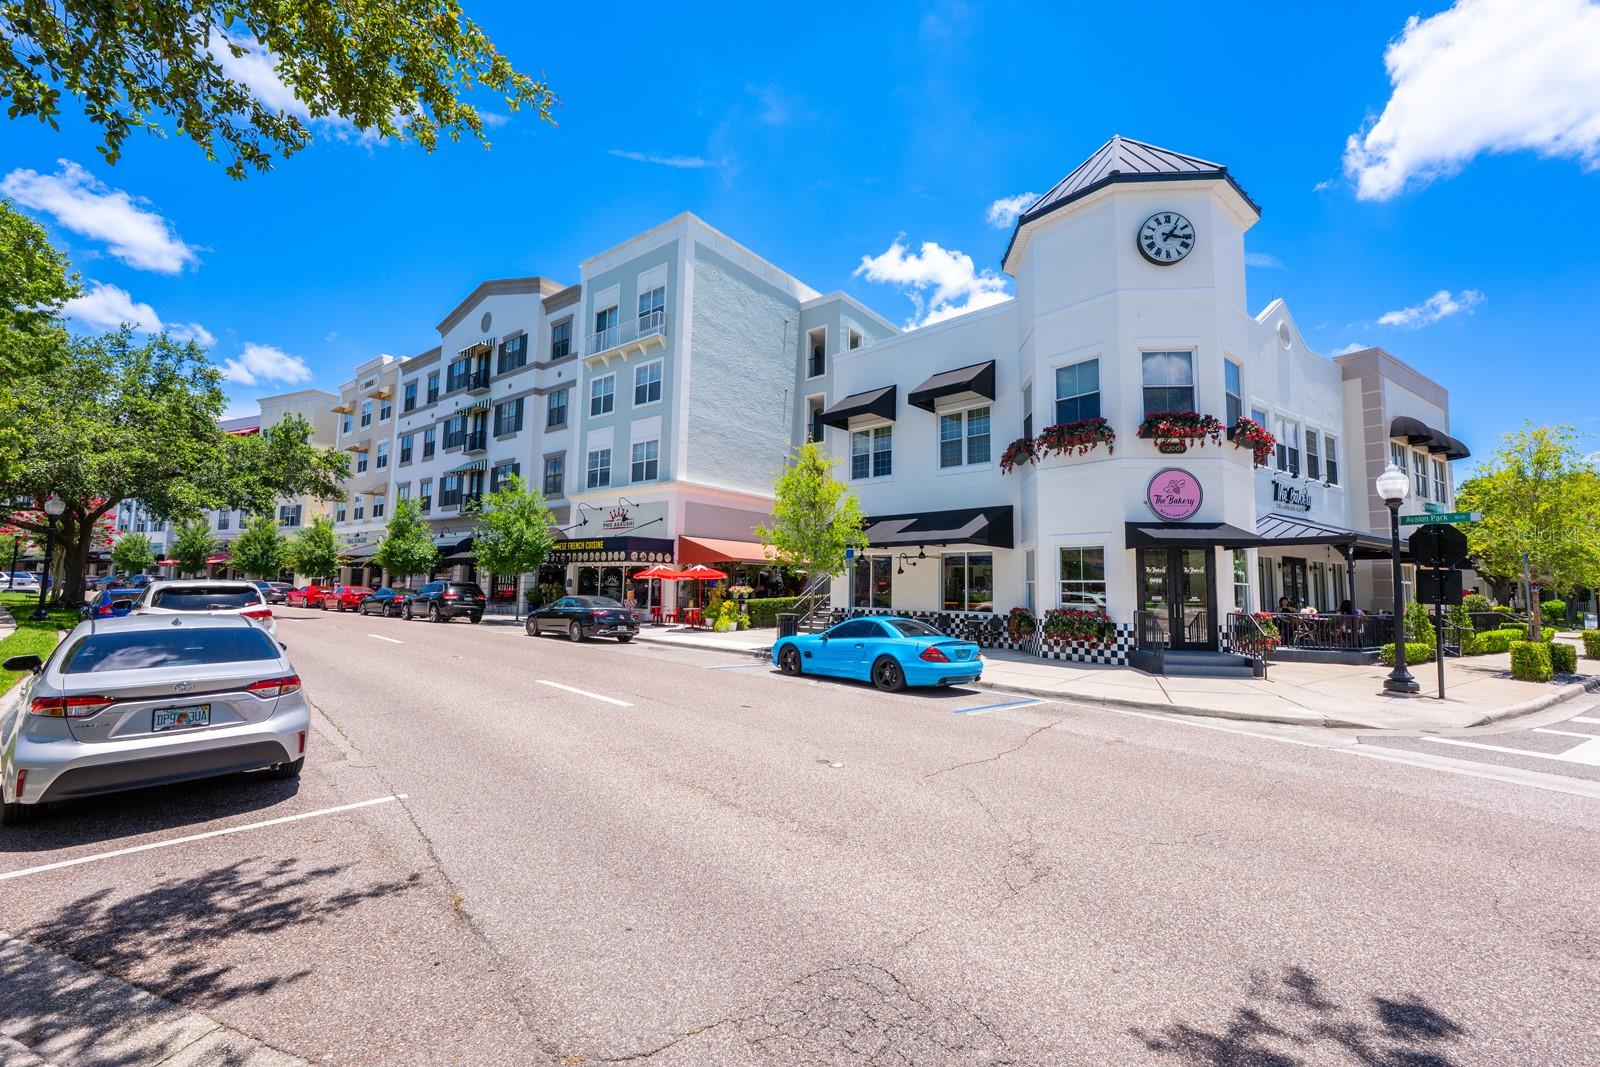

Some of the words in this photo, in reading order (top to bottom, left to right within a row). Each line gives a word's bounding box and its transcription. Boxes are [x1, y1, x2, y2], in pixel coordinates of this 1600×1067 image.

[1271, 480, 1290, 503] The
[1154, 494, 1165, 504] The
[1166, 494, 1195, 506] Bakery
[1430, 514, 1448, 522] Park
[568, 541, 585, 550] FRENCH
[585, 540, 604, 550] CUISINE
